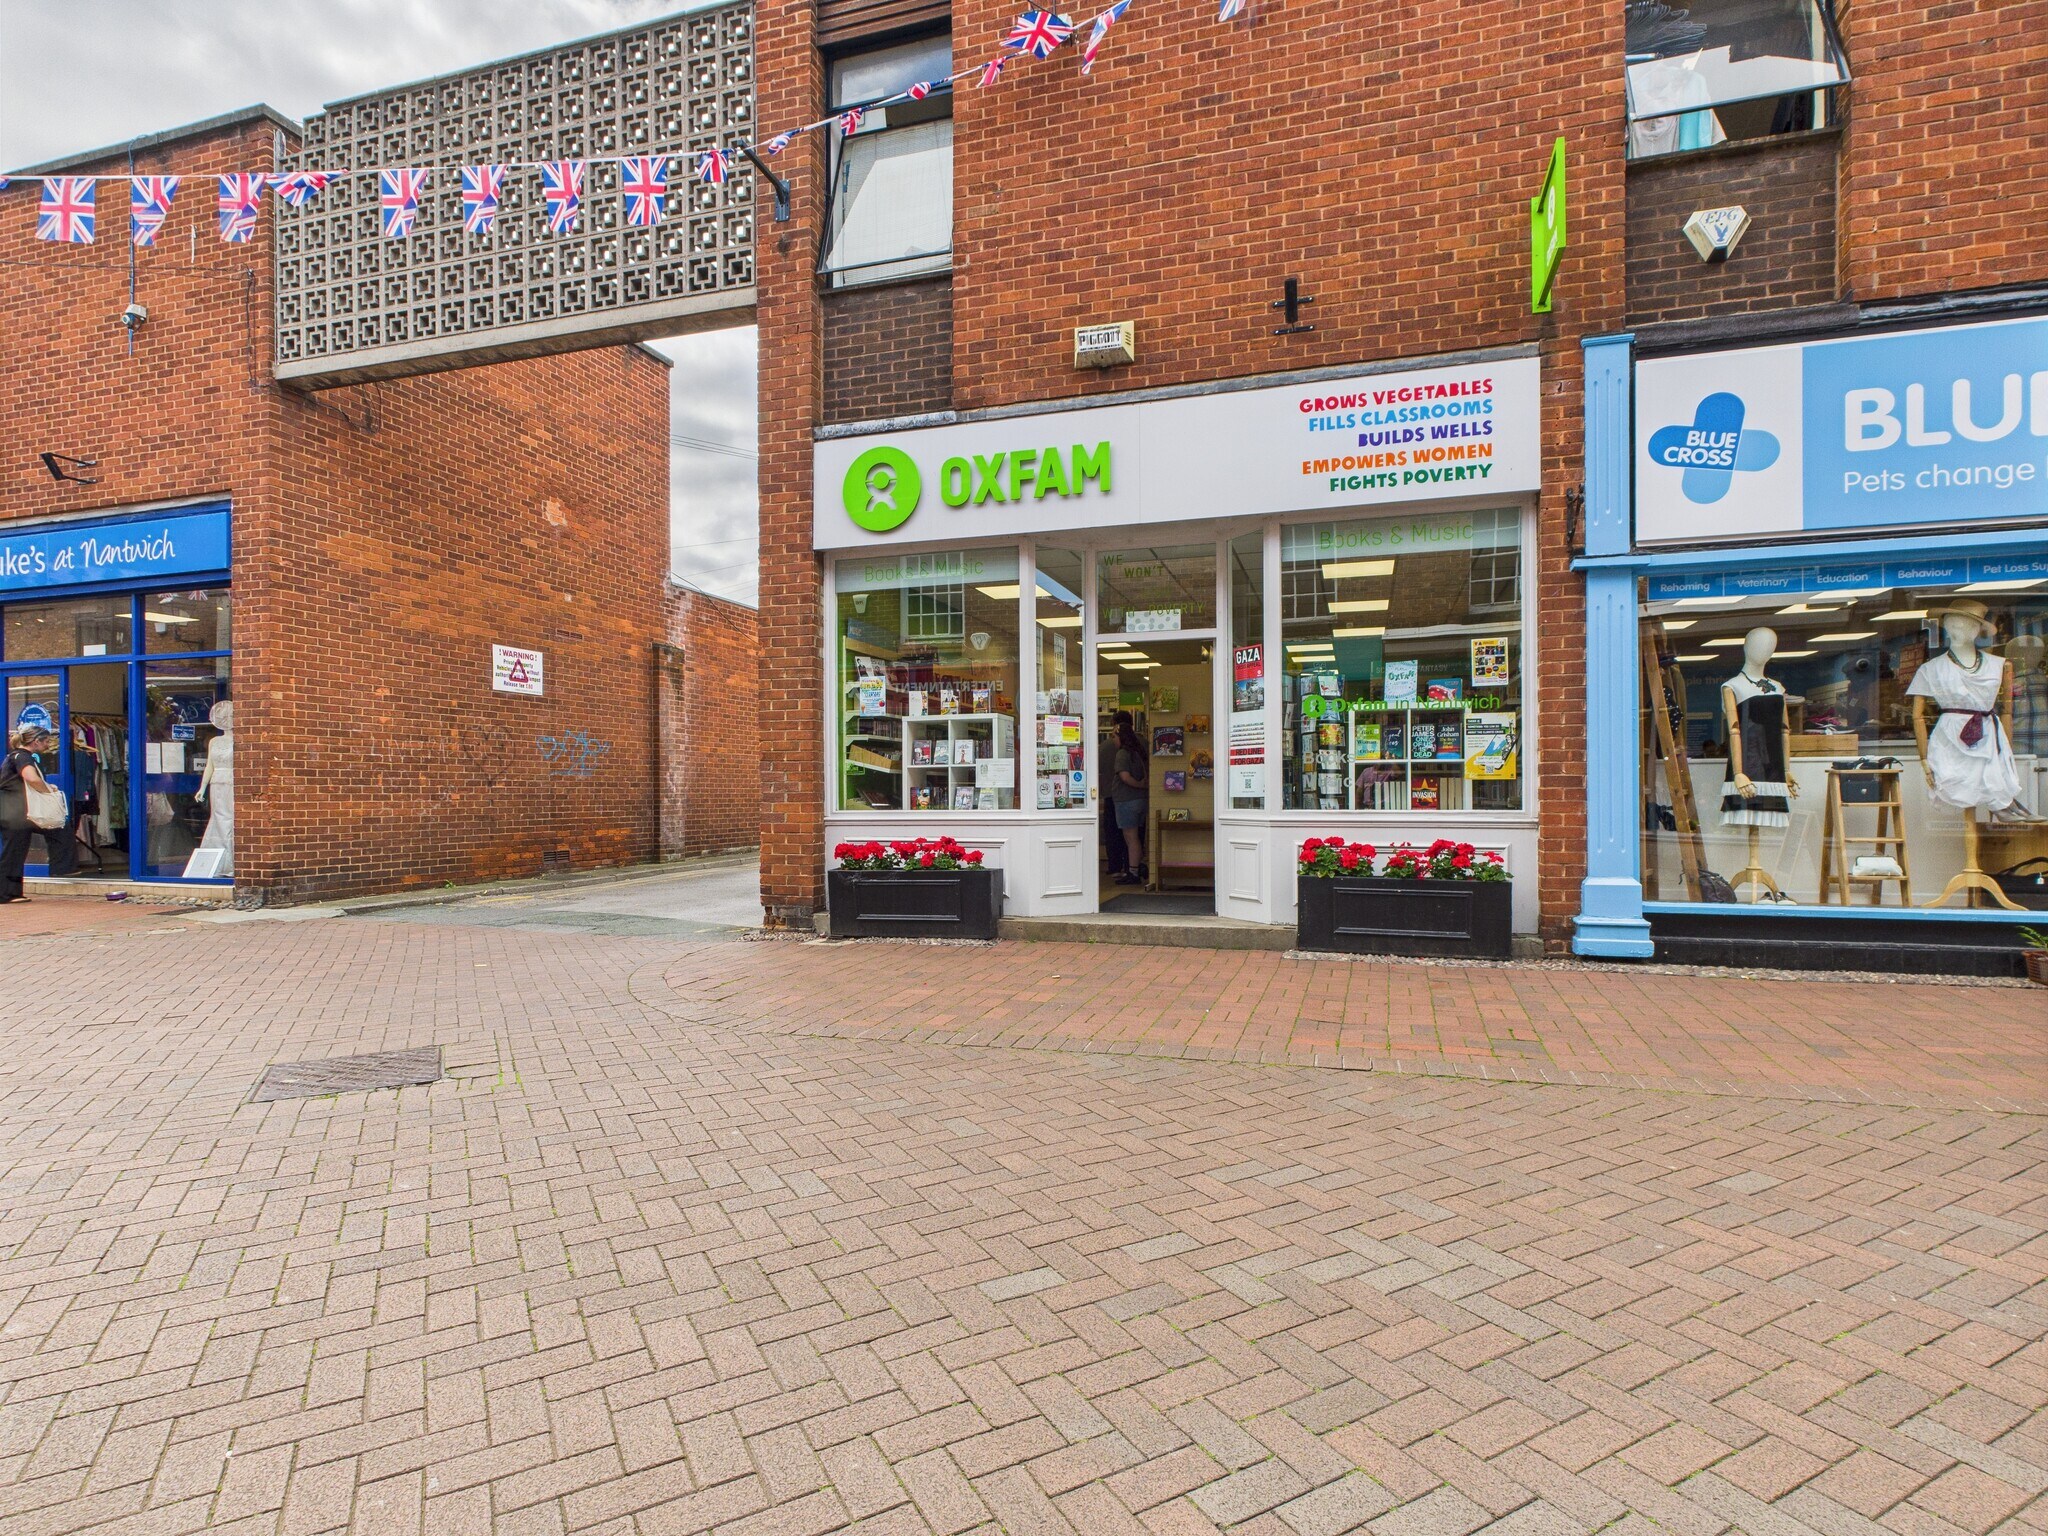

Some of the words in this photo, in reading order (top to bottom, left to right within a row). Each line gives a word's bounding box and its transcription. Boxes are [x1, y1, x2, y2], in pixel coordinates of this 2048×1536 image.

[1299, 392, 1367, 414] GROWS
[1373, 378, 1493, 405] VEGETABLES
[1309, 413, 1356, 432] FILLS
[1361, 399, 1493, 427] CLASSROOMS
[1844, 371, 2048, 452] BLU
[1358, 426, 1425, 447] BUILDS
[1431, 420, 1493, 440] WELLS
[1686, 430, 1738, 449] BLUE
[1302, 450, 1407, 475] EMPOWERS
[1413, 443, 1492, 464] WOMEN
[1663, 446, 1735, 466] CROSS
[940, 441, 1111, 508] OXFAM
[1329, 472, 1397, 492] FIGHTS
[1403, 463, 1493, 486] POVERTY
[1843, 469, 1905, 494] Pets
[1915, 462, 2036, 489] change
[1319, 528, 1383, 550] Books
[1390, 524, 1403, 545] &
[1412, 520, 1474, 543] Music
[0, 545, 46, 577] ke's
[53, 547, 75, 571] at
[80, 528, 176, 568] Nantwich
[1103, 554, 1124, 566] WE
[864, 564, 914, 583] Books
[919, 561, 929, 577] &
[936, 559, 984, 577] Music
[1124, 565, 1164, 578] WON'T
[1660, 580, 1711, 593] Rehoming
[1737, 576, 1789, 590] Veterinary
[1816, 571, 1869, 584] Education
[1897, 567, 1954, 580] Behaviour
[1983, 563, 2001, 574] Pet
[2004, 561, 2028, 573] Loss
[1149, 601, 1205, 617] POVERTY
[503, 658, 515, 667] Privat
[1236, 647, 1260, 665] GAZA
[1332, 696, 1388, 713] Oxfam
[1395, 695, 1410, 710] in
[1416, 693, 1500, 711] Nantwich
[1302, 751, 1356, 764] Books
[1413, 751, 1433, 759] DEAD
[1411, 791, 1437, 799] INVASION
